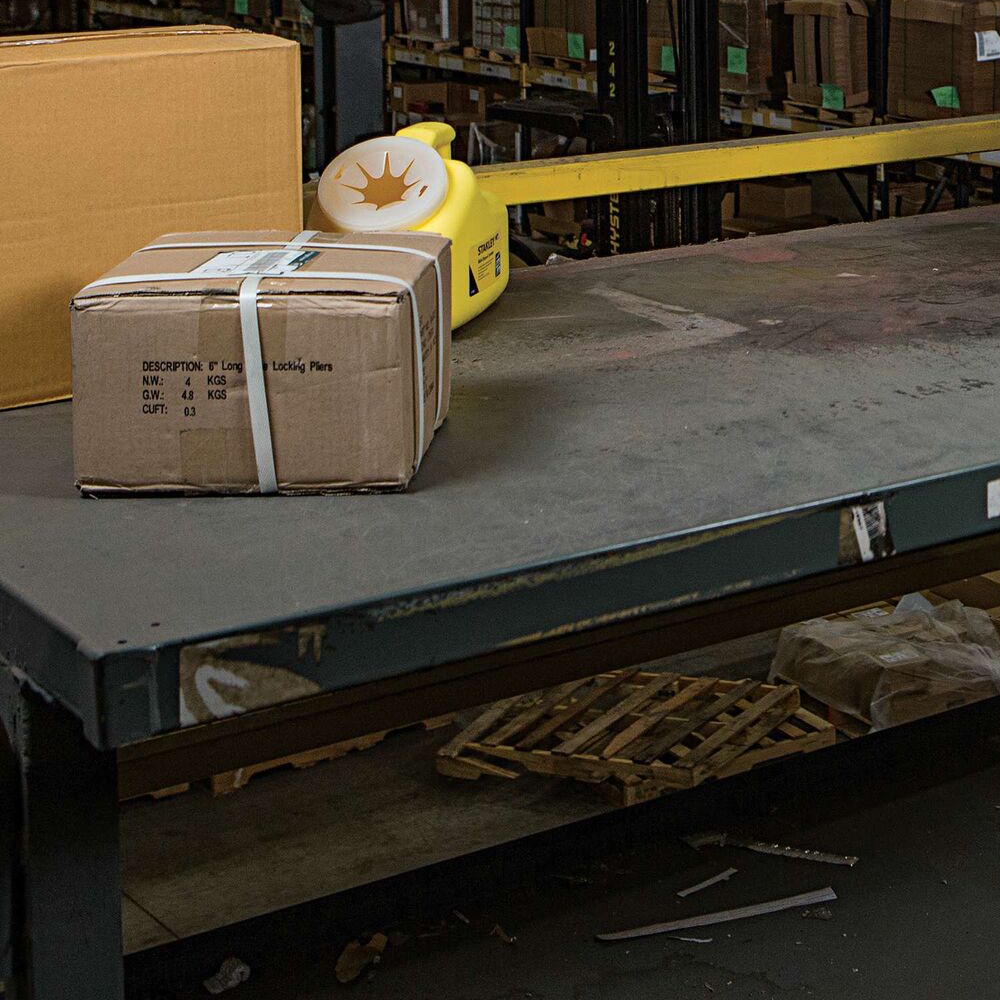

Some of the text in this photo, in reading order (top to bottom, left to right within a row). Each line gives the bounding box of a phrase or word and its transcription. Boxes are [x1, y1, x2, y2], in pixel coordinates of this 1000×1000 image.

[477, 237, 495, 256] STANLEY
[142, 360, 203, 372] DESCRIPTION:
[221, 361, 243, 374] Long
[272, 360, 306, 374] Locking
[309, 360, 333, 372] Pliers
[184, 376, 191, 387] 4
[206, 375, 227, 386] KGS
[181, 391, 194, 401] 4.8
[207, 389, 227, 400] KGS
[142, 404, 196, 417] CUFT: 0.3
